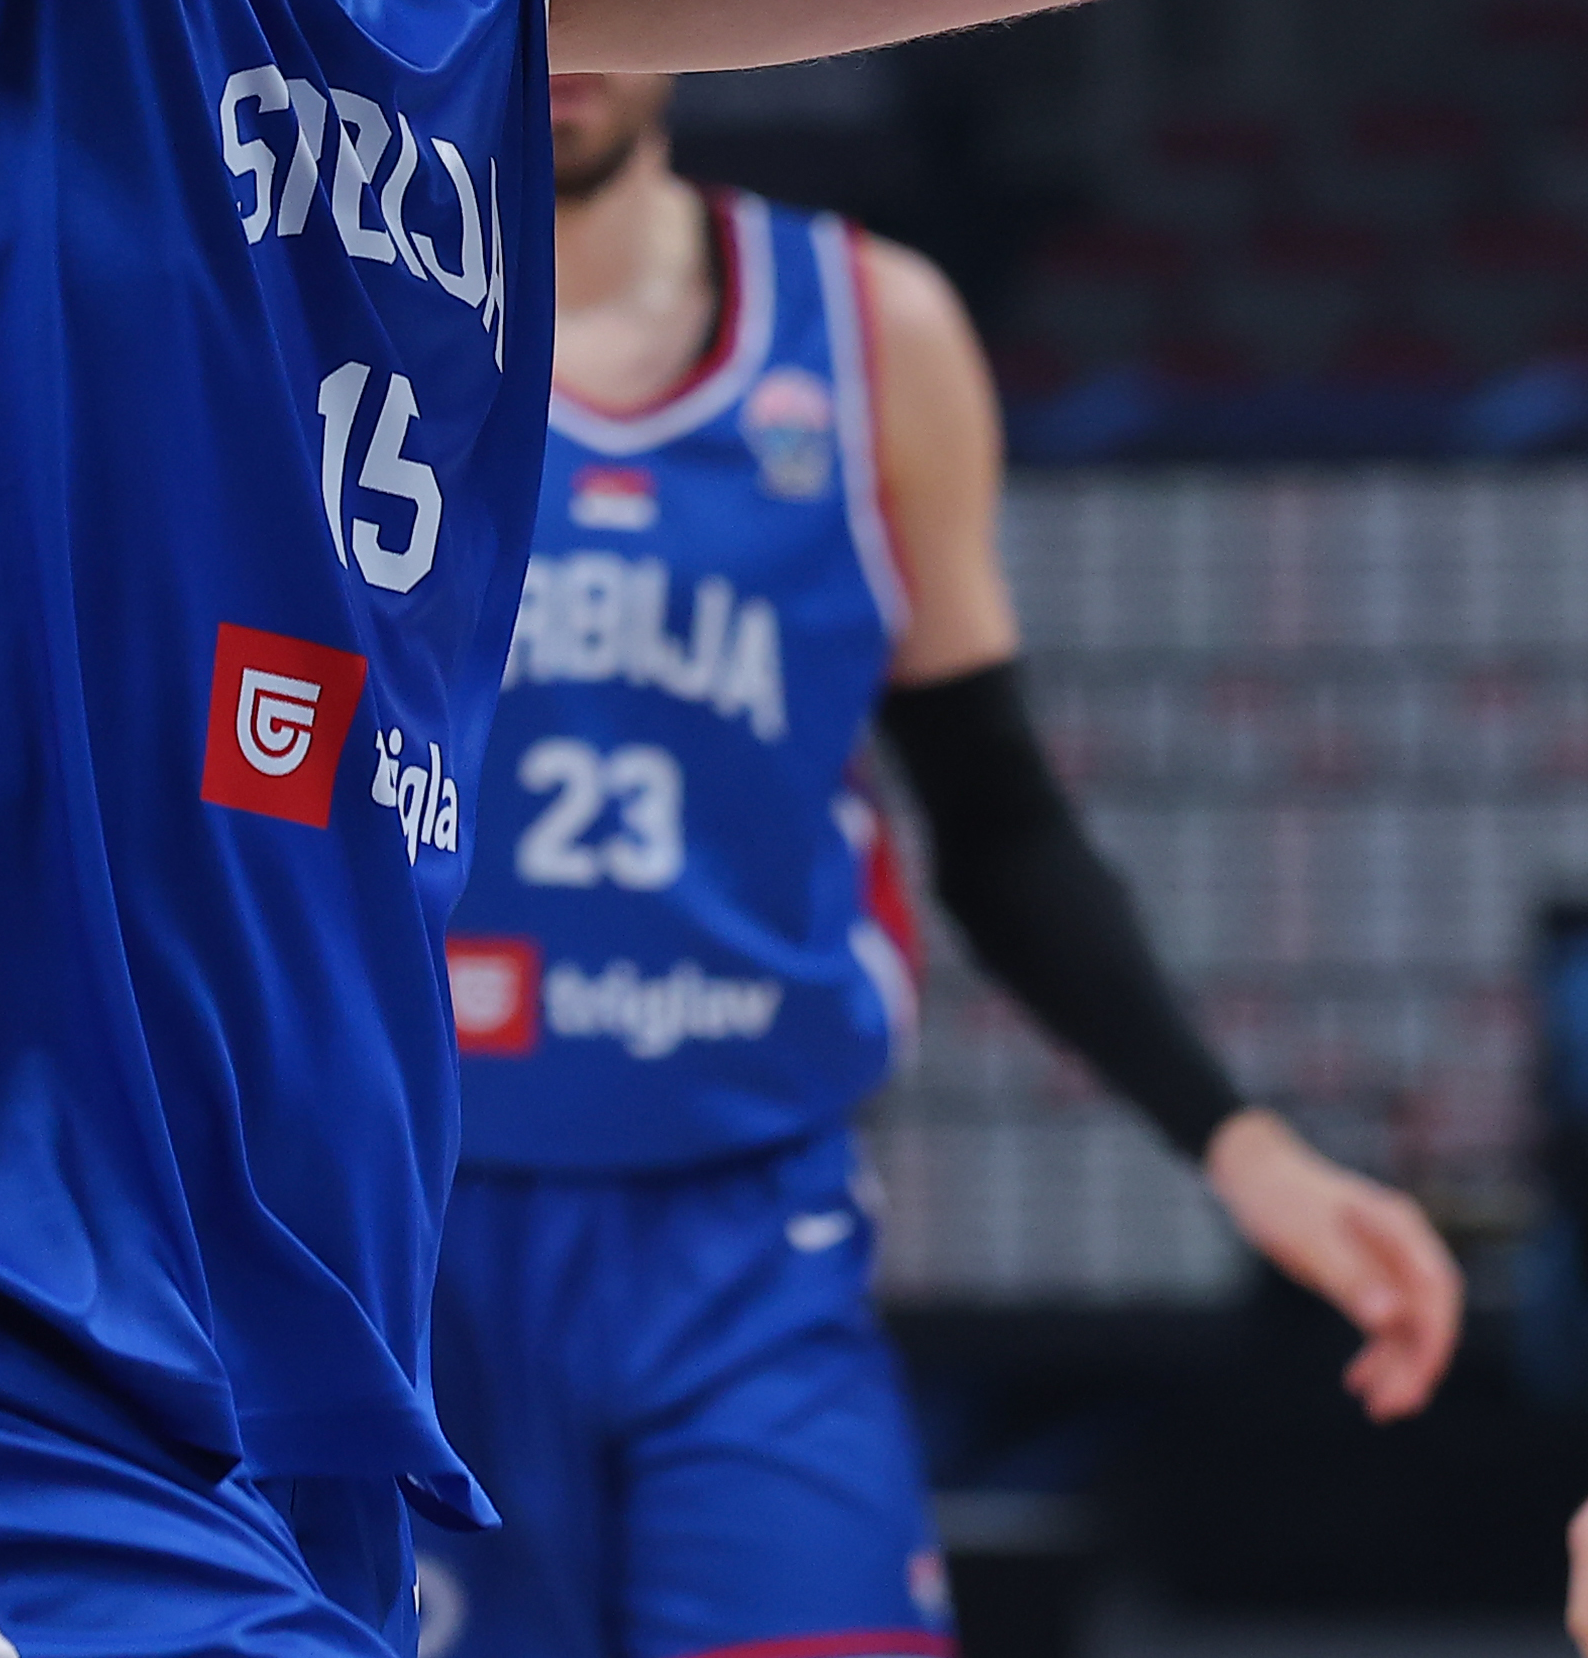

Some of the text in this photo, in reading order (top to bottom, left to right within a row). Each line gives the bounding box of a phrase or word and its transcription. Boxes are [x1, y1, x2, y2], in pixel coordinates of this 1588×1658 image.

[318, 360, 443, 594] 15
[501, 552, 789, 744] RBIJA
[516, 737, 685, 893] 23
